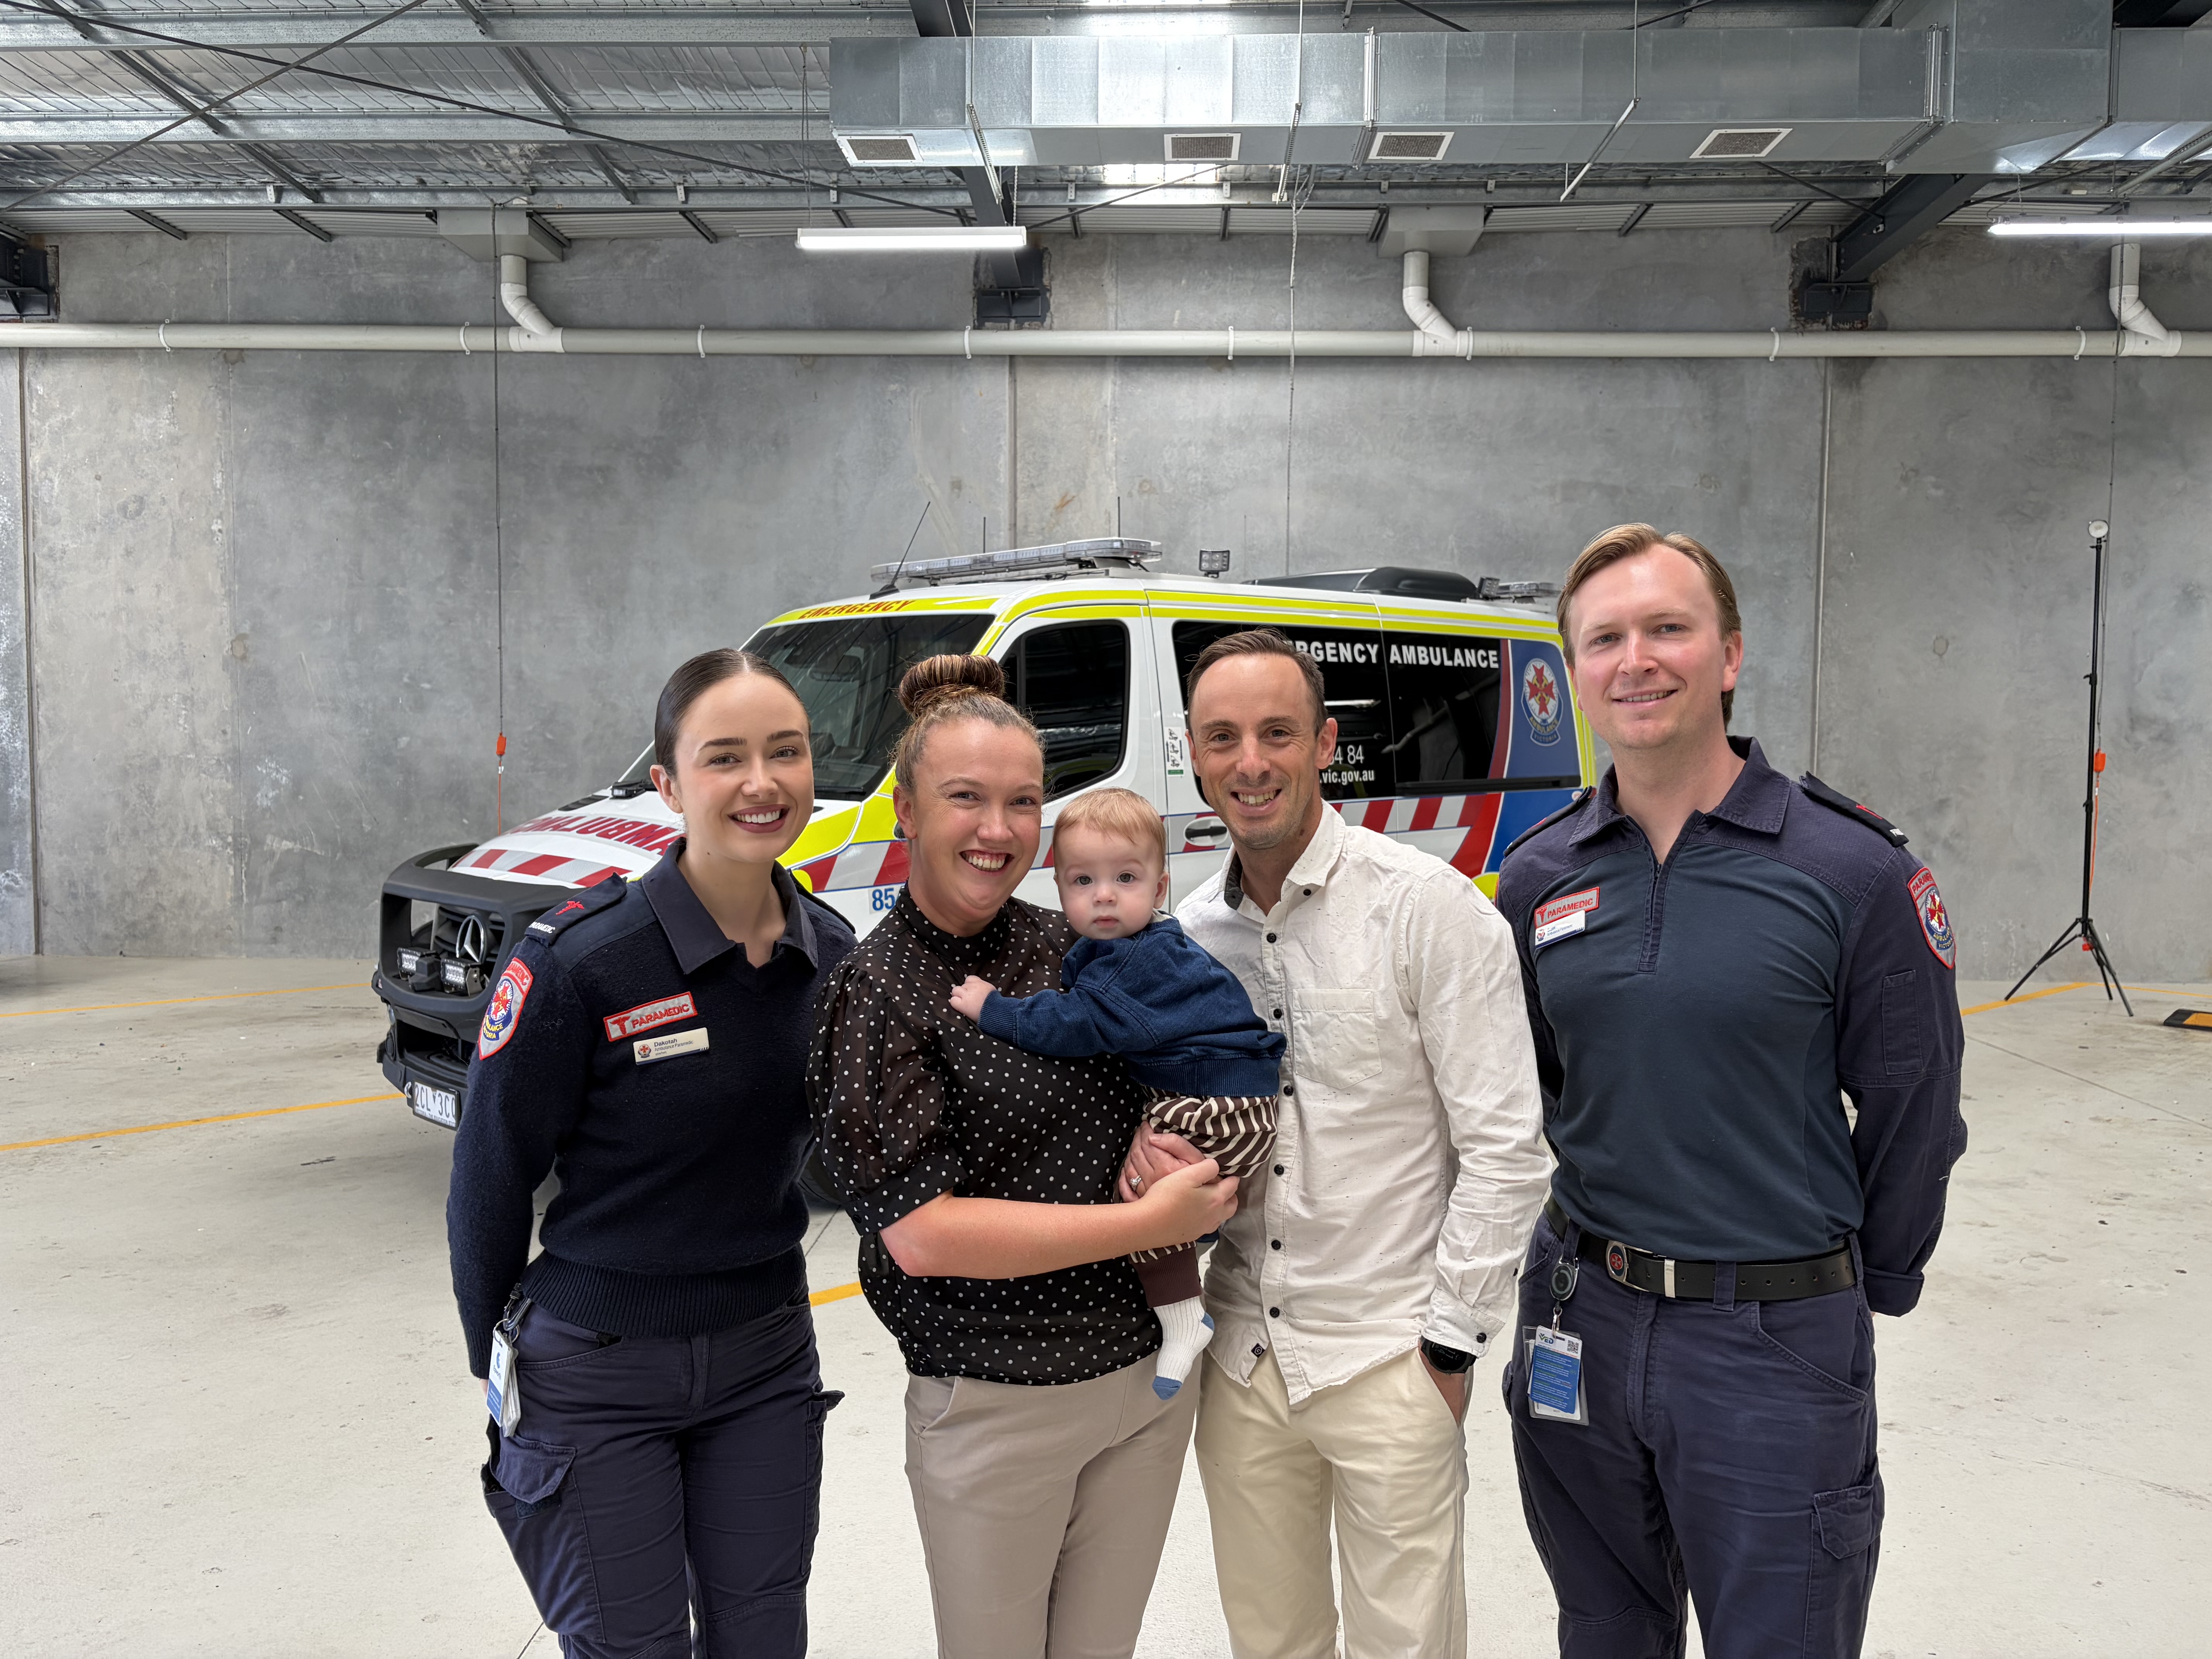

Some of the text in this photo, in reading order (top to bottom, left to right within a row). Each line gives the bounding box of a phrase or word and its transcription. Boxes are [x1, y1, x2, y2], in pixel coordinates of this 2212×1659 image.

[797, 600, 917, 620] EMERGENCY
[1389, 645, 1499, 668] AMBULANCE
[1347, 744, 1365, 764] 84
[1547, 898, 1593, 919] PARAMEDIC
[631, 1003, 690, 1029] PARAMEDIC
[654, 1038, 677, 1047] Dakotah
